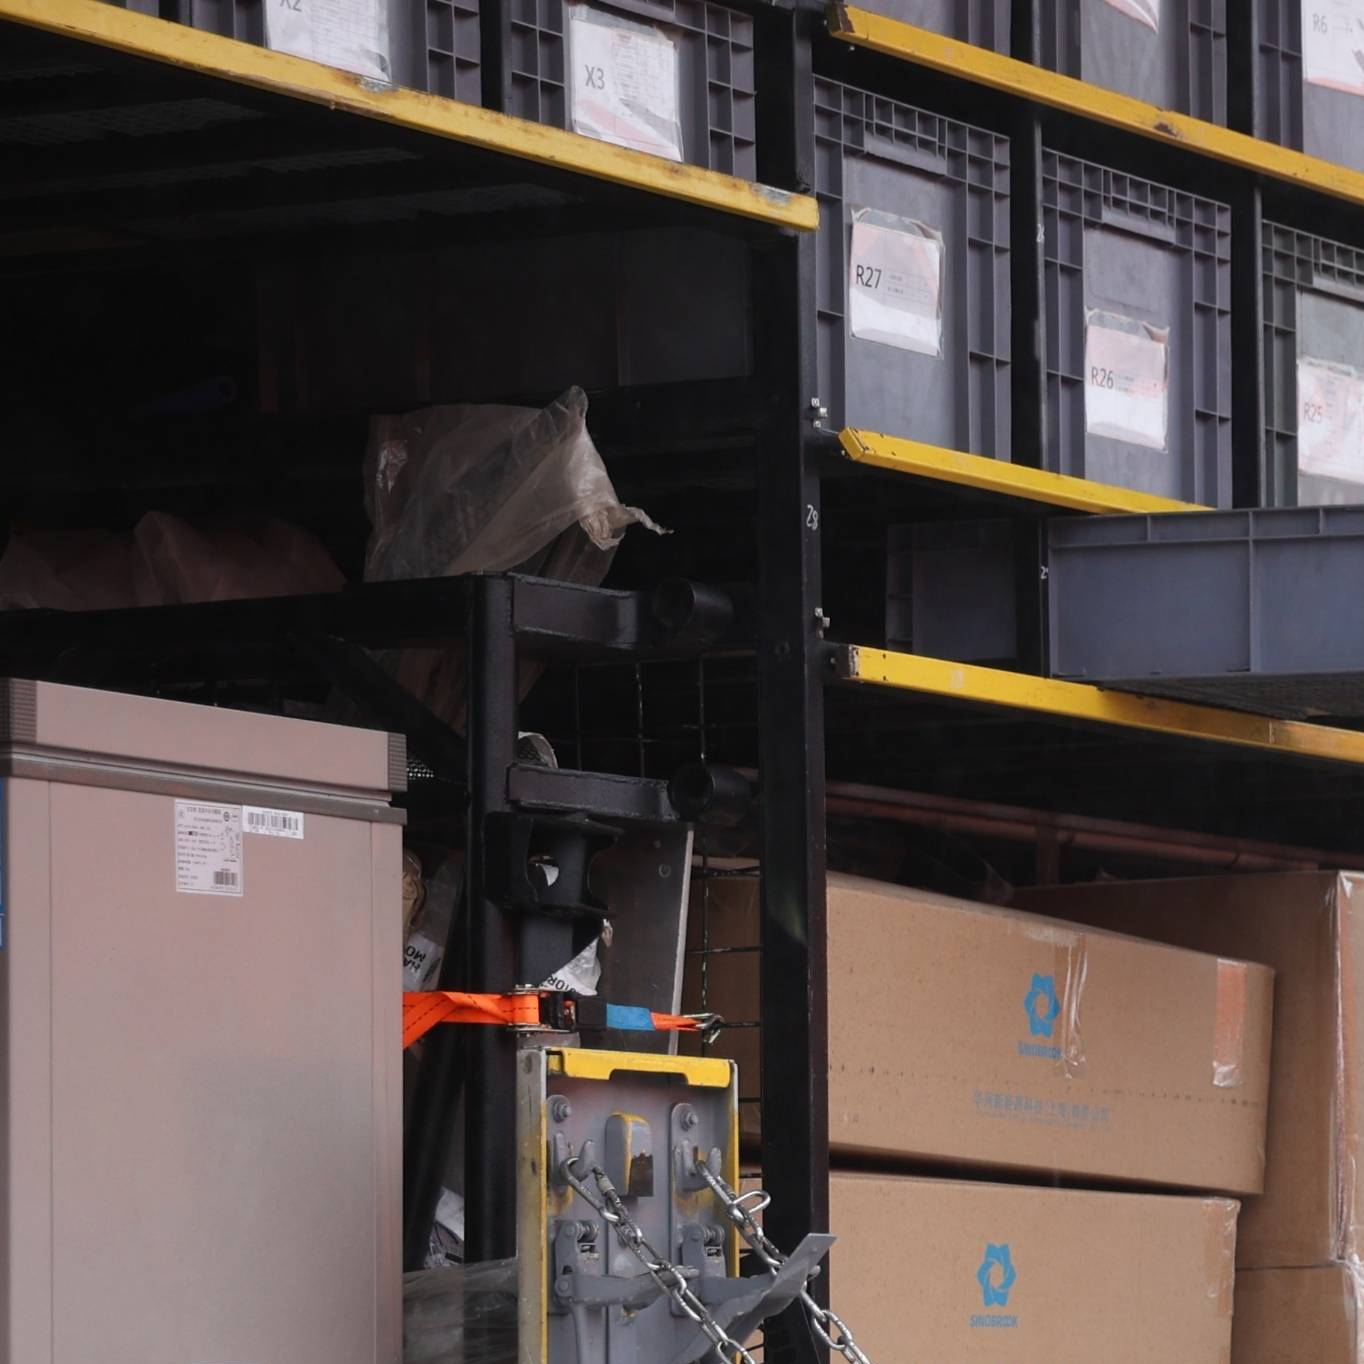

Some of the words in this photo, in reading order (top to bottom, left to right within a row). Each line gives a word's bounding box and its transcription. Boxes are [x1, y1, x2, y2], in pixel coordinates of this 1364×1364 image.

[1312, 13, 1328, 34] R6
[584, 63, 606, 90] X3
[855, 264, 883, 289] R27
[1090, 365, 1115, 390] R26
[1303, 401, 1323, 425] R25
[806, 503, 819, 531] 28
